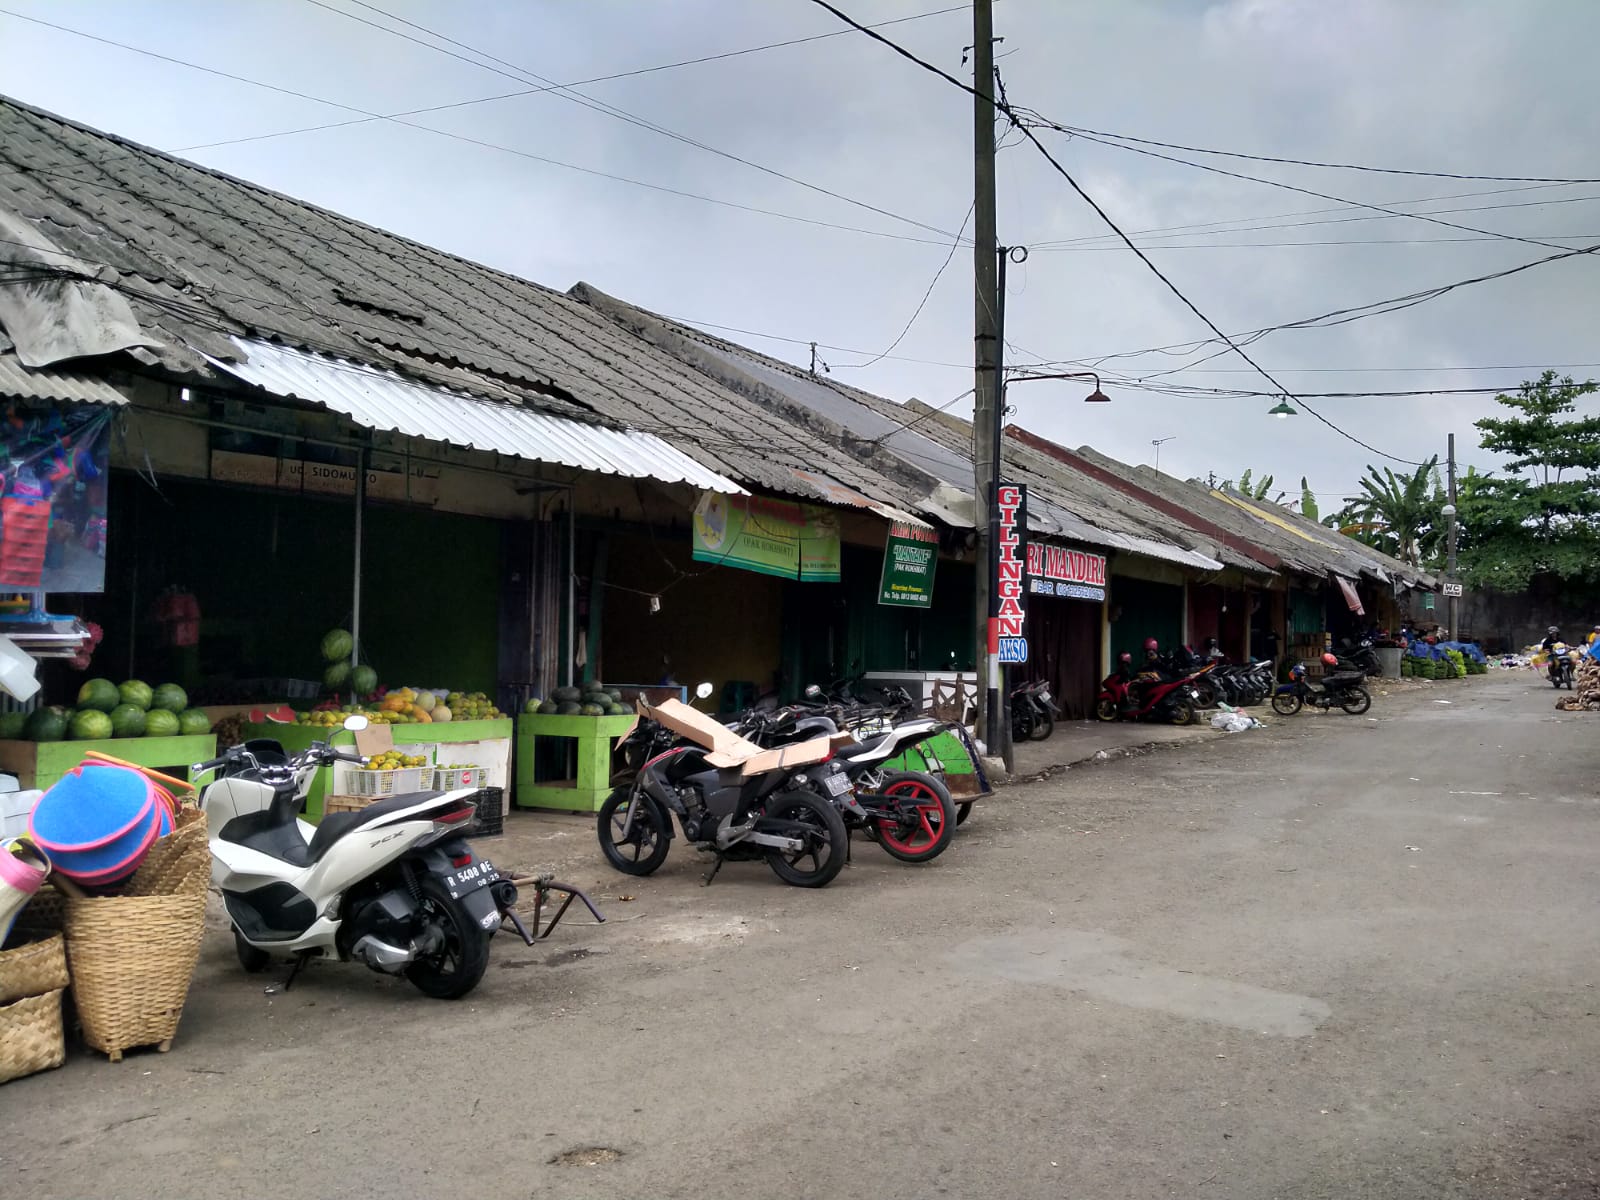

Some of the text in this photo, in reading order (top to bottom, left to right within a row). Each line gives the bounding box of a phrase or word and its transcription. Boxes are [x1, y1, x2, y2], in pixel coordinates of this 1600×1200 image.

[312, 467, 377, 484] SIDOMUO
[998, 486, 1025, 637] GILINGAN
[1045, 544, 1106, 586] MANDIRI
[447, 876, 456, 887] R
